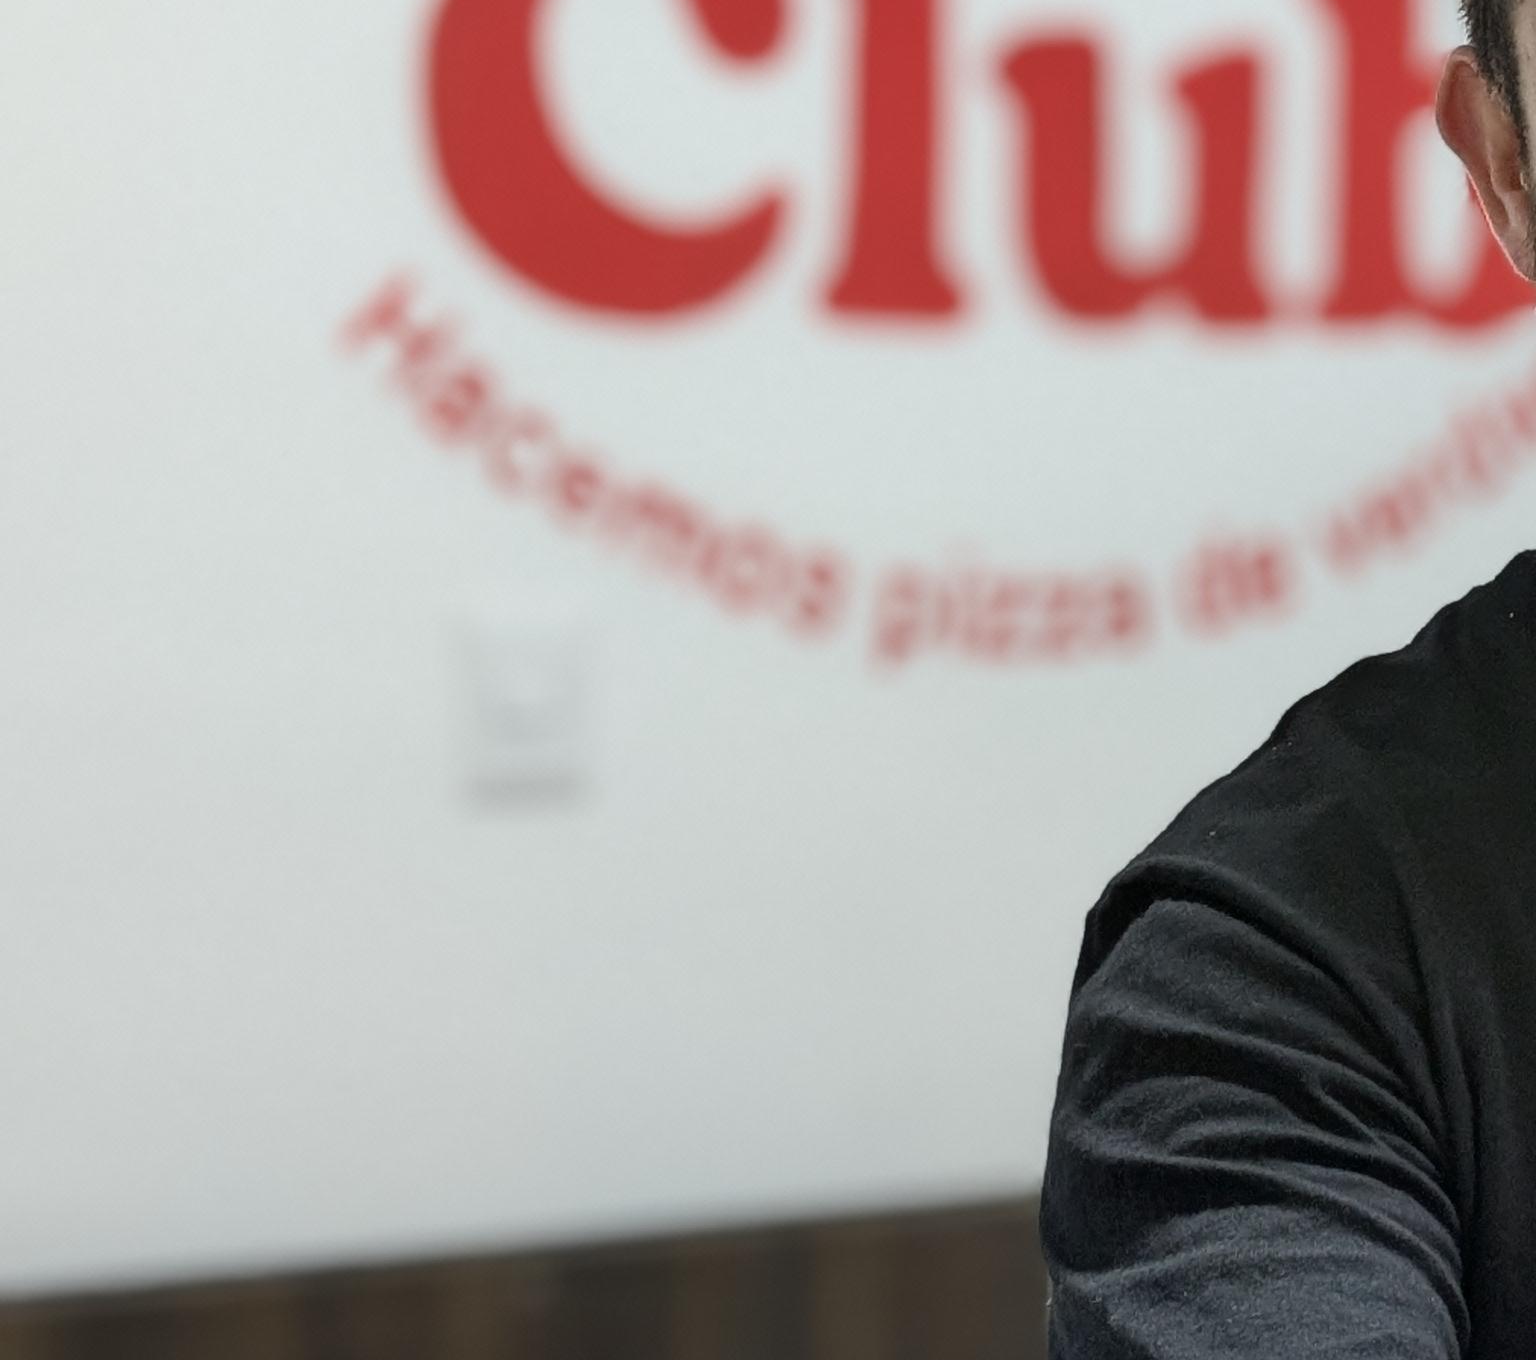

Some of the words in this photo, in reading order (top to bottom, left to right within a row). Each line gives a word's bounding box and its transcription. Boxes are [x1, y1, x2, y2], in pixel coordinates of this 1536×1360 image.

[340, 274, 847, 635] Hacemos
[873, 566, 1150, 666] pizza
[1182, 540, 1294, 634] de
